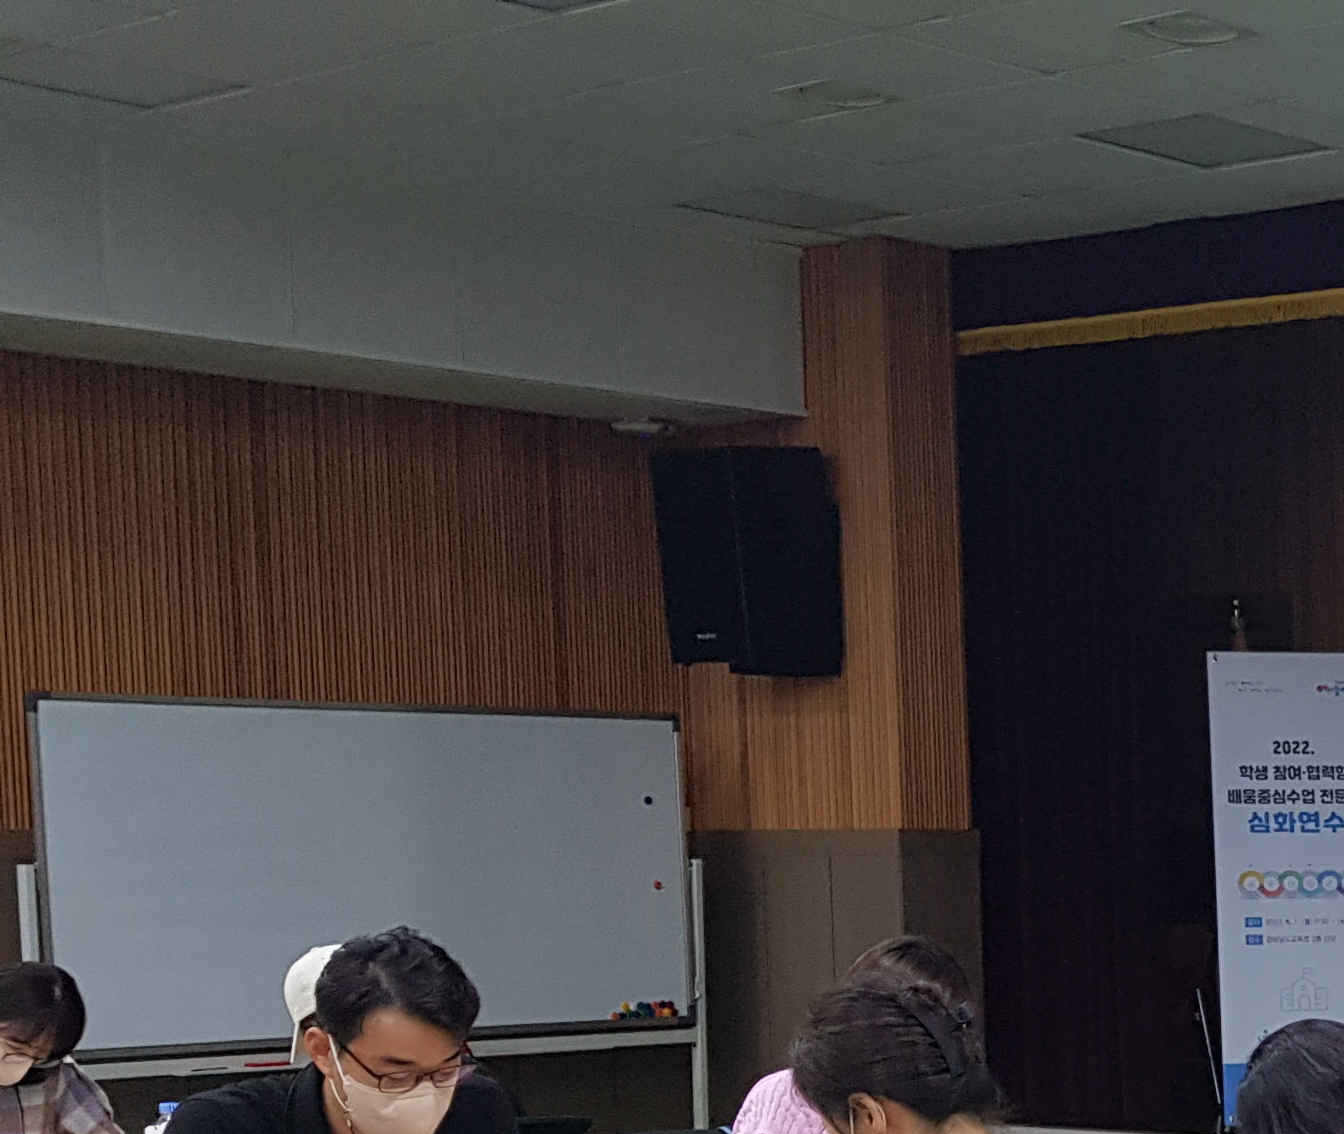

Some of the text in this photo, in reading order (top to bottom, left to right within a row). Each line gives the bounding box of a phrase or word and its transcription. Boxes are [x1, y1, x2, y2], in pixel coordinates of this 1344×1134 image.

[1272, 740, 1315, 755] 2022.
[1239, 765, 1268, 780] 학생
[1227, 789, 1315, 804] 배움중심수업
